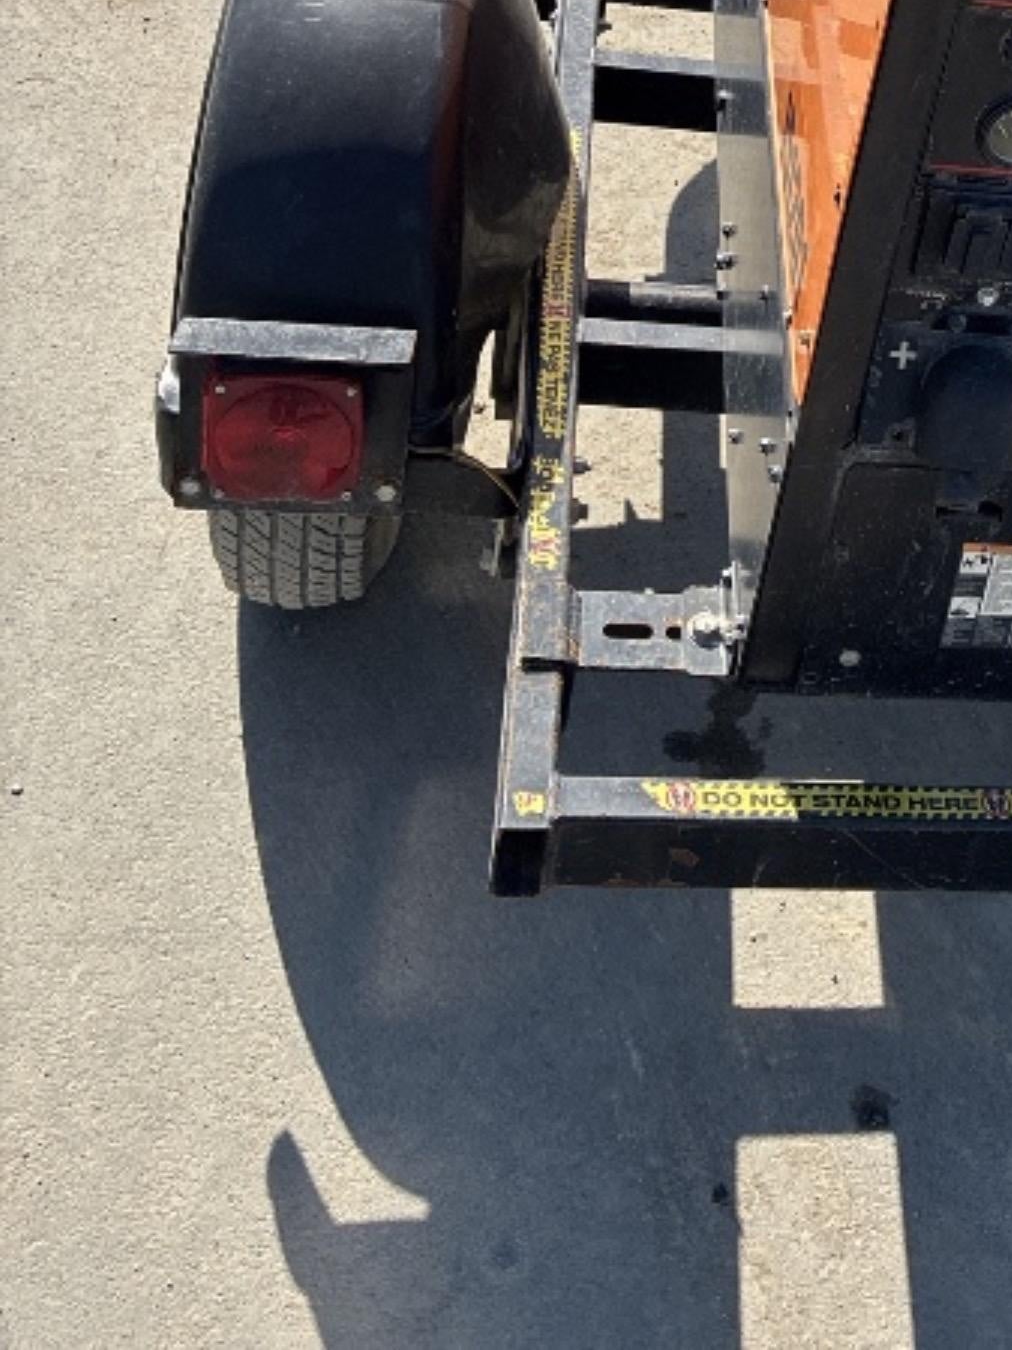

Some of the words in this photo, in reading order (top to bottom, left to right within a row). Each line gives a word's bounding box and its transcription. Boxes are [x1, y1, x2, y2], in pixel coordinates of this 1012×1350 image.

[704, 791, 742, 809] DO
[750, 791, 807, 809] NOT
[812, 793, 902, 810] STAND
[908, 795, 983, 812] HERE
